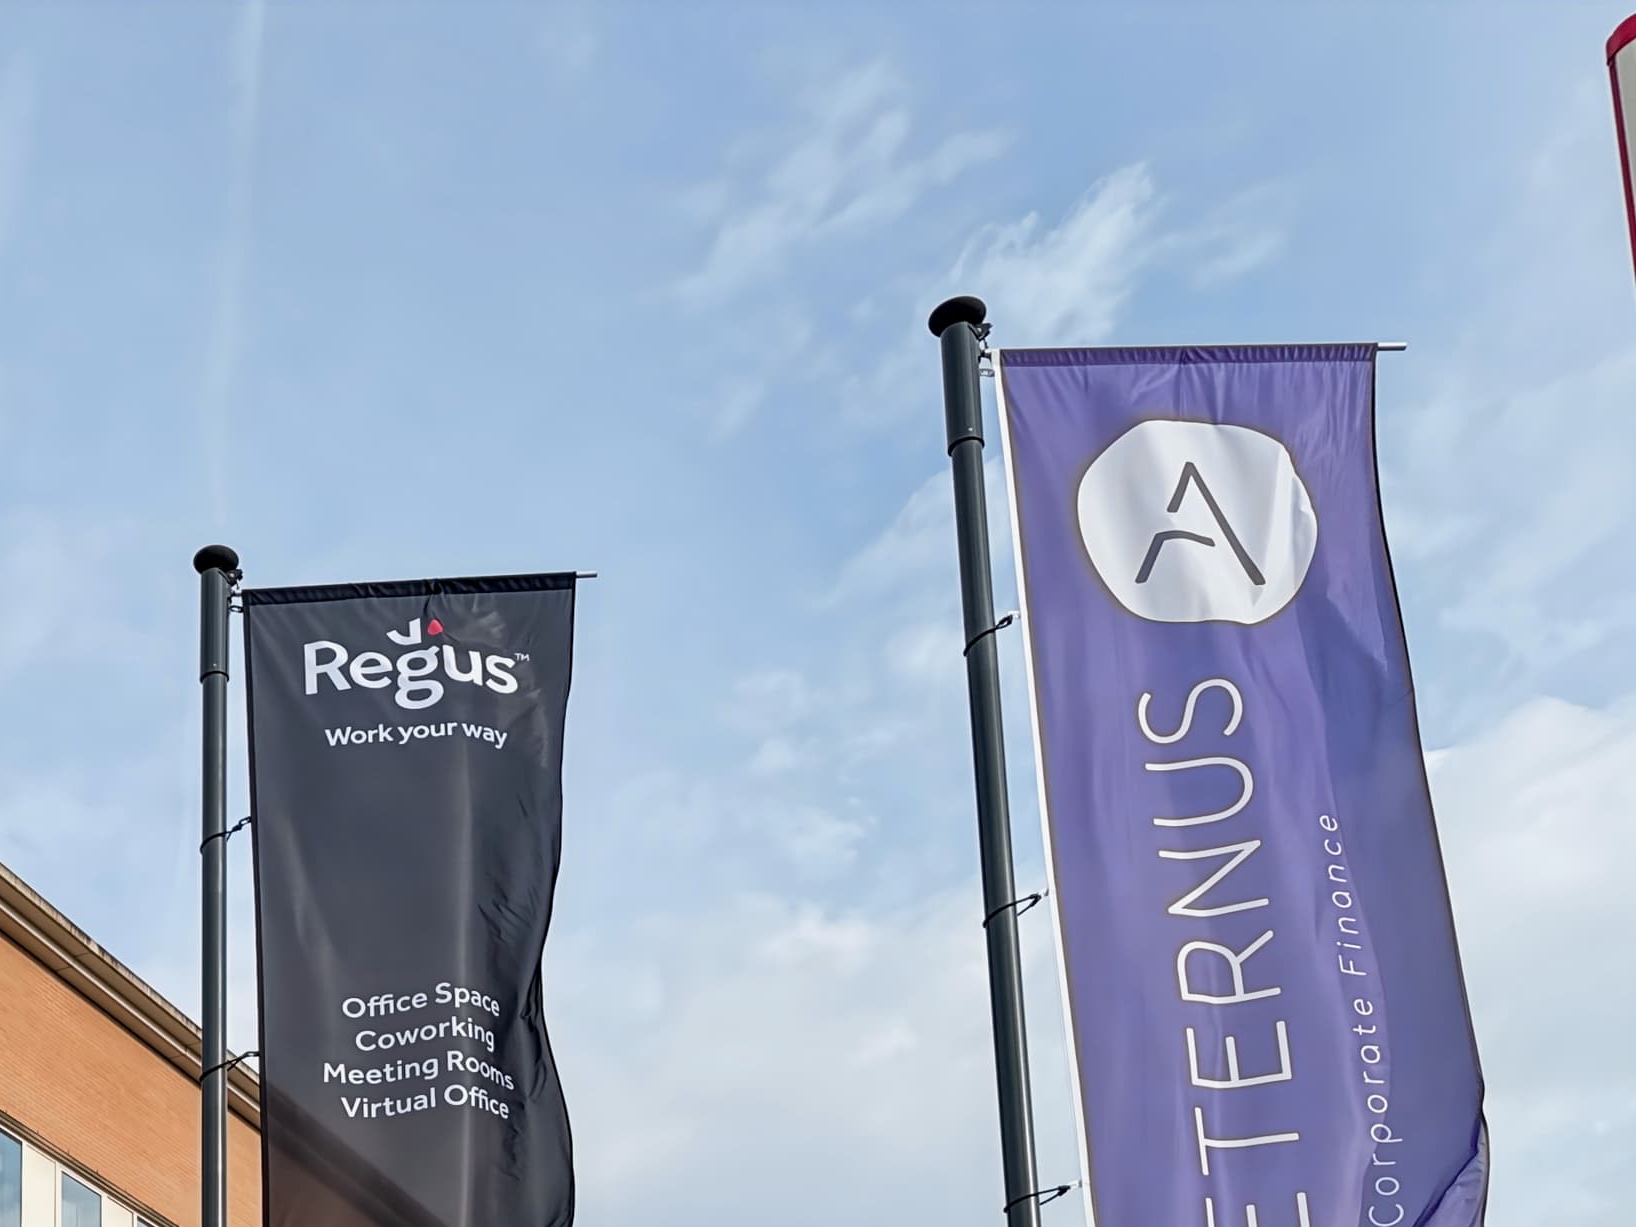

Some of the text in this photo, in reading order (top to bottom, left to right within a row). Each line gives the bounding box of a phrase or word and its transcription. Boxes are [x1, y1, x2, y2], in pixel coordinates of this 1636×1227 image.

[303, 640, 519, 710] Regus
[325, 722, 508, 750] Work your way
[1319, 813, 1367, 977] Finance
[342, 982, 500, 1018] Office Space
[355, 1016, 495, 1053] Coworking
[323, 1050, 514, 1090] Meeting Rooms
[340, 1084, 509, 1119] Virtual Office
